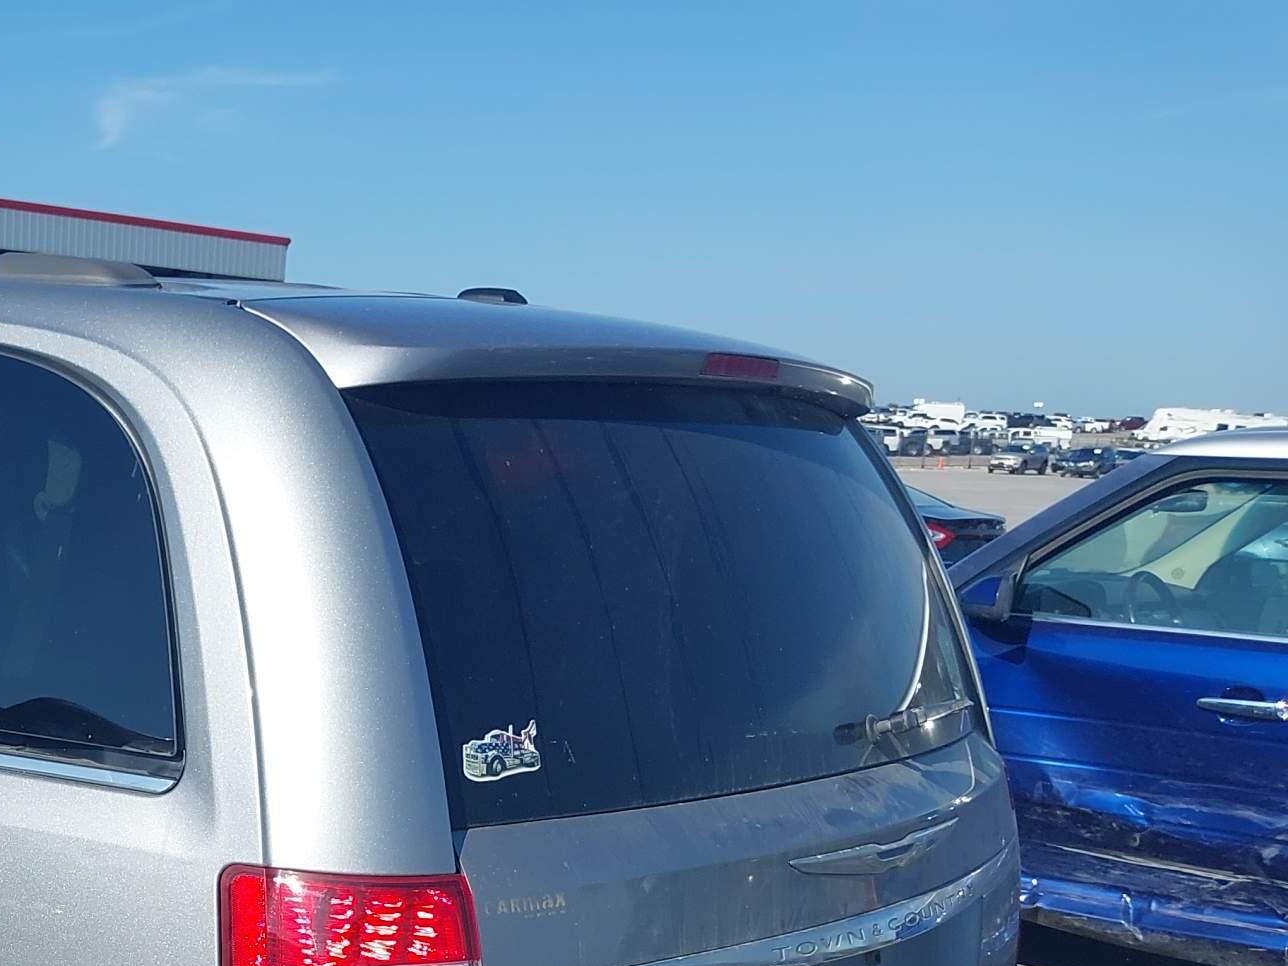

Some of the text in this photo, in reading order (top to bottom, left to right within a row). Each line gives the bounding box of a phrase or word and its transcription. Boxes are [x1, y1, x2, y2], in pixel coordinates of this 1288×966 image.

[771, 882, 976, 962] TOWN & COUNTRY
